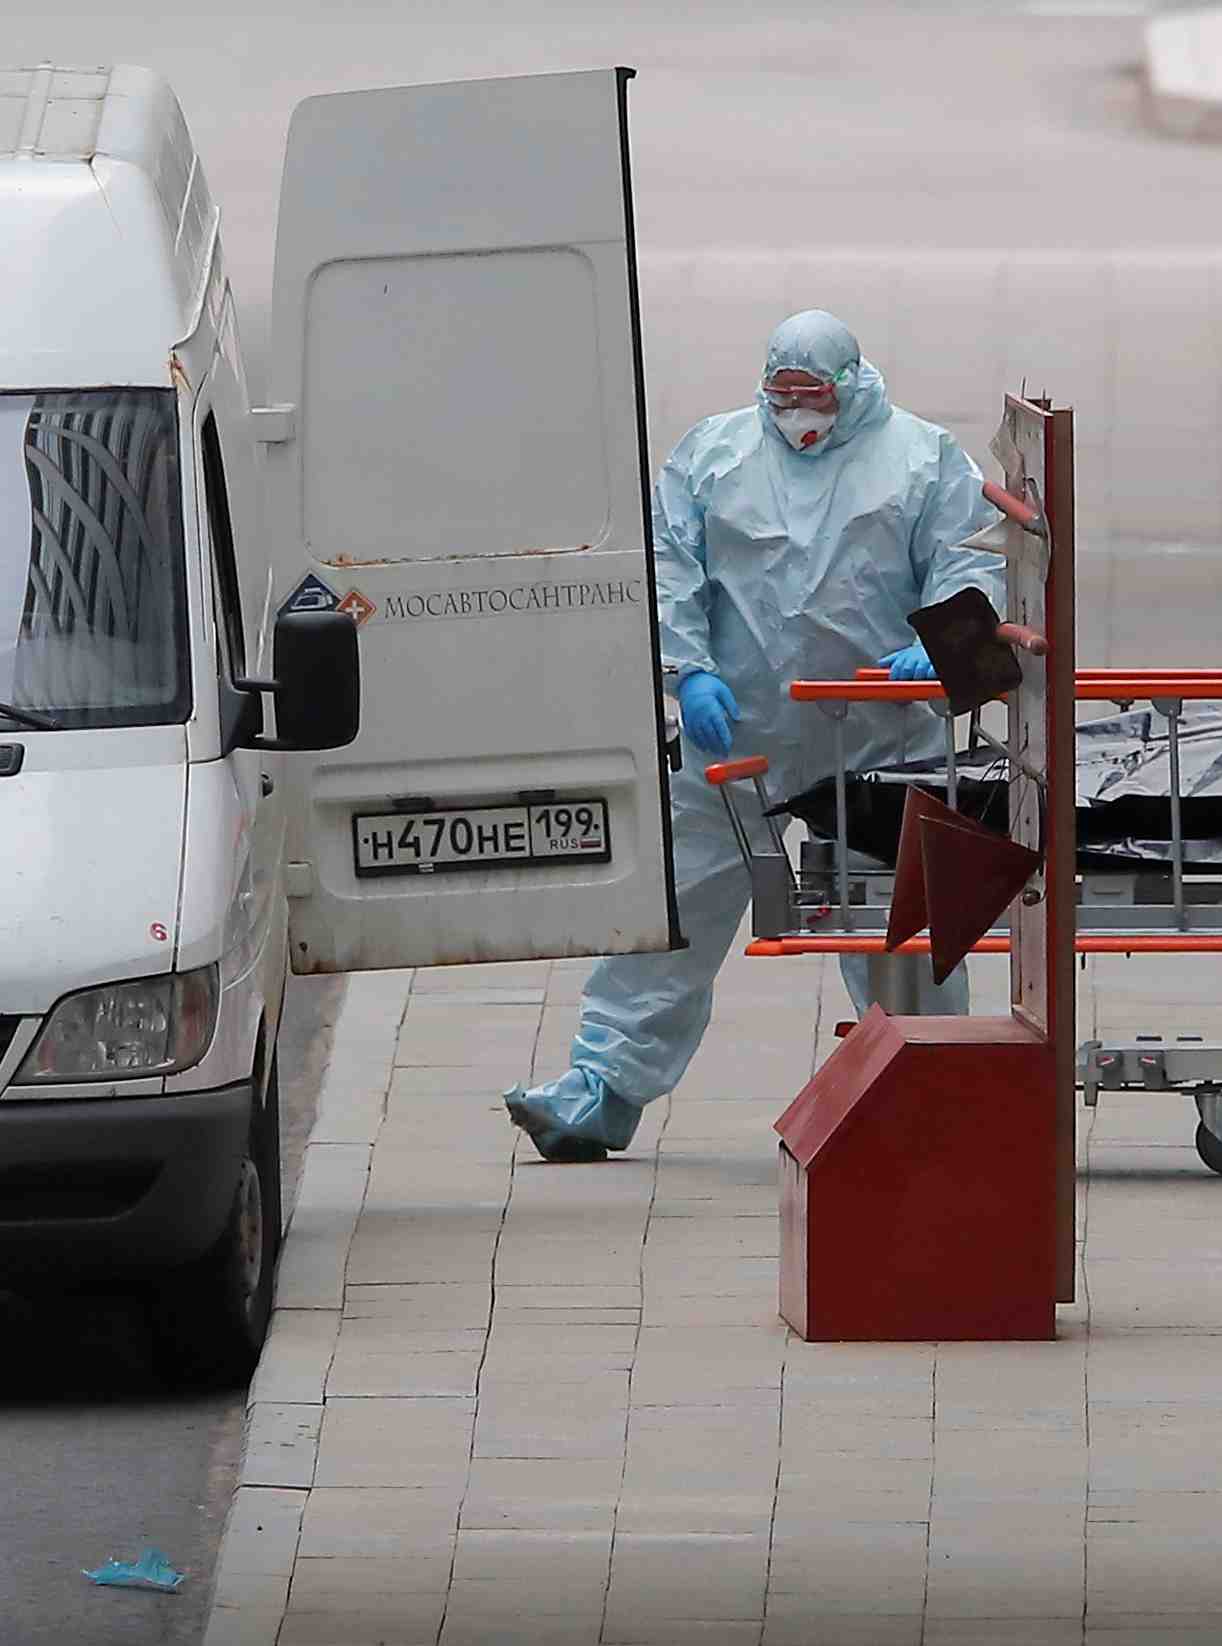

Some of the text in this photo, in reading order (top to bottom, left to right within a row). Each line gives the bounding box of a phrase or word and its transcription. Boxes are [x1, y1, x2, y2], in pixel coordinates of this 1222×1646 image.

[384, 580, 641, 618] МОСАВТОСАНТРАНС
[372, 807, 593, 861] Н470НЕ 199
[550, 838, 578, 850] RUS
